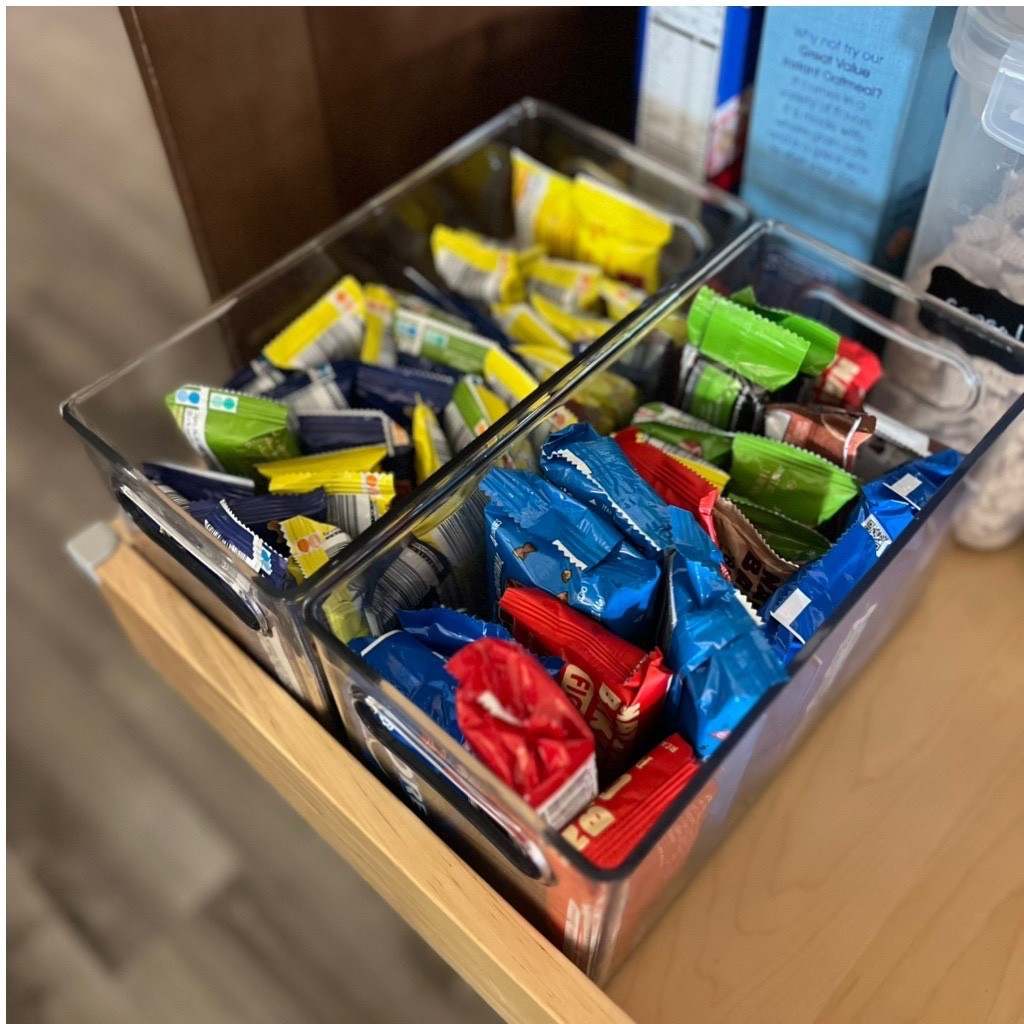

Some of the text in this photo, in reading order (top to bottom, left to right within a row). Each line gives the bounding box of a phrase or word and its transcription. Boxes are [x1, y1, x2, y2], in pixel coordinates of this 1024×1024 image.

[798, 46, 872, 79] Great Value
[862, 52, 884, 65] our
[824, 72, 884, 98] Oatmeal?
